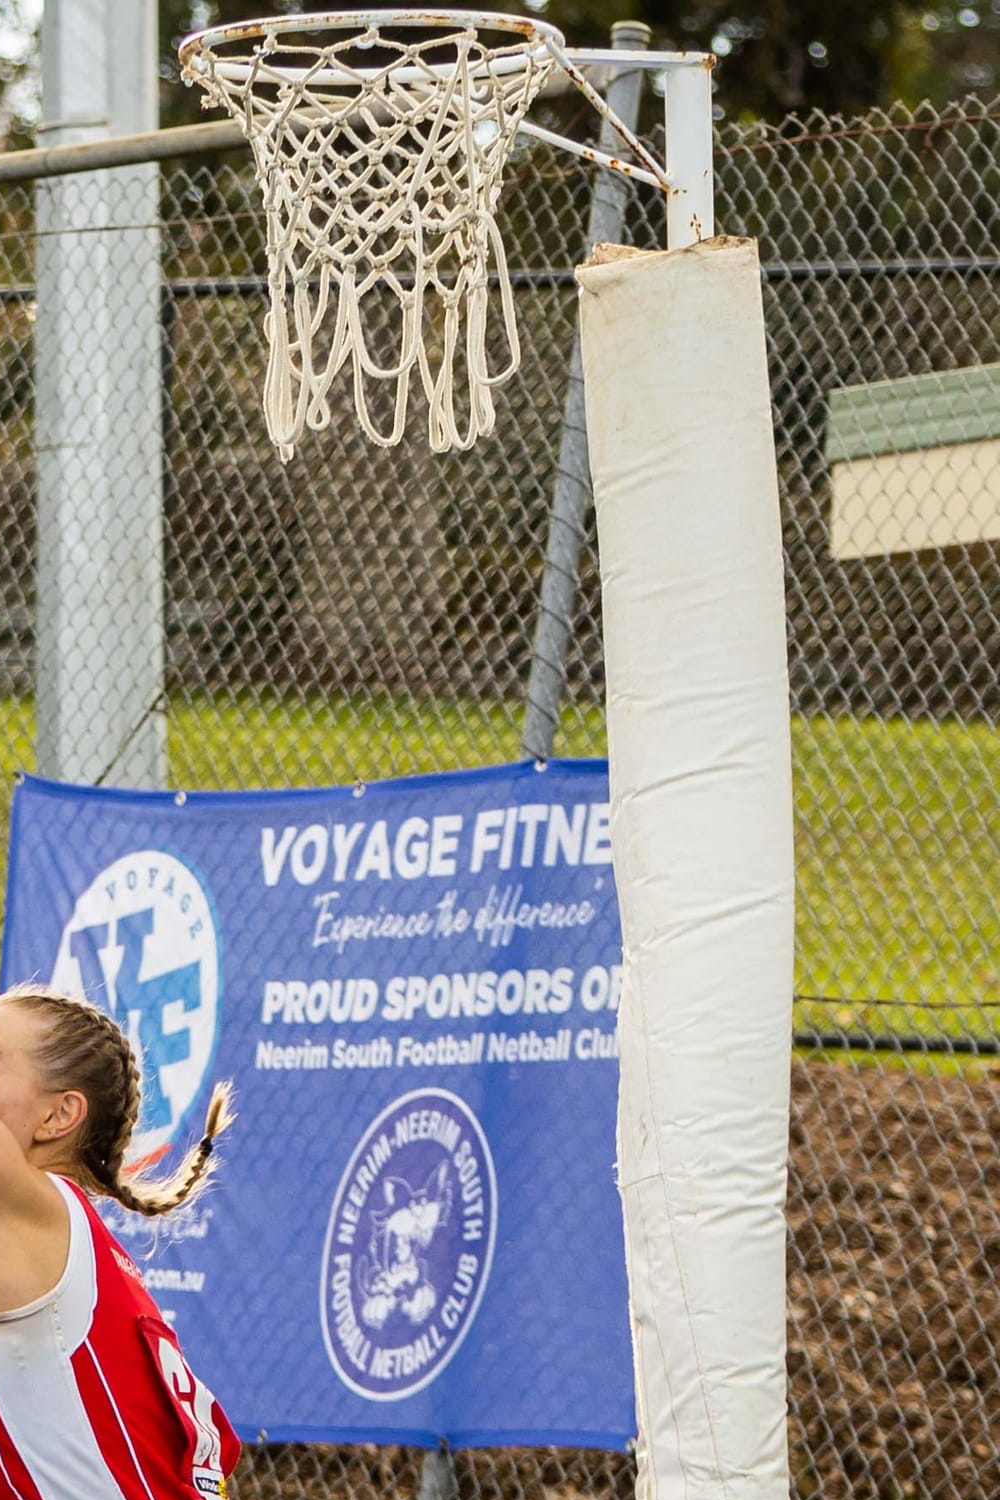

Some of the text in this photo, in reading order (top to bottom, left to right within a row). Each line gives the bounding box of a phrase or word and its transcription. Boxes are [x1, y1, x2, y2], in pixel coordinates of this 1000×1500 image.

[261, 803, 614, 886] VOYAGE FITNE
[103, 866, 205, 941] VOYAGE
[433, 888, 472, 940] the
[261, 978, 379, 1025] PROUD
[381, 967, 575, 1021] SPONSORS
[255, 1039, 328, 1071] Neerim
[331, 1037, 393, 1070] South
[395, 1032, 484, 1068] Football
[487, 1028, 571, 1063] Netball
[453, 1140, 484, 1241] SOUTH
[331, 1252, 480, 1380] FOOTBALL NETBALL CLUB
